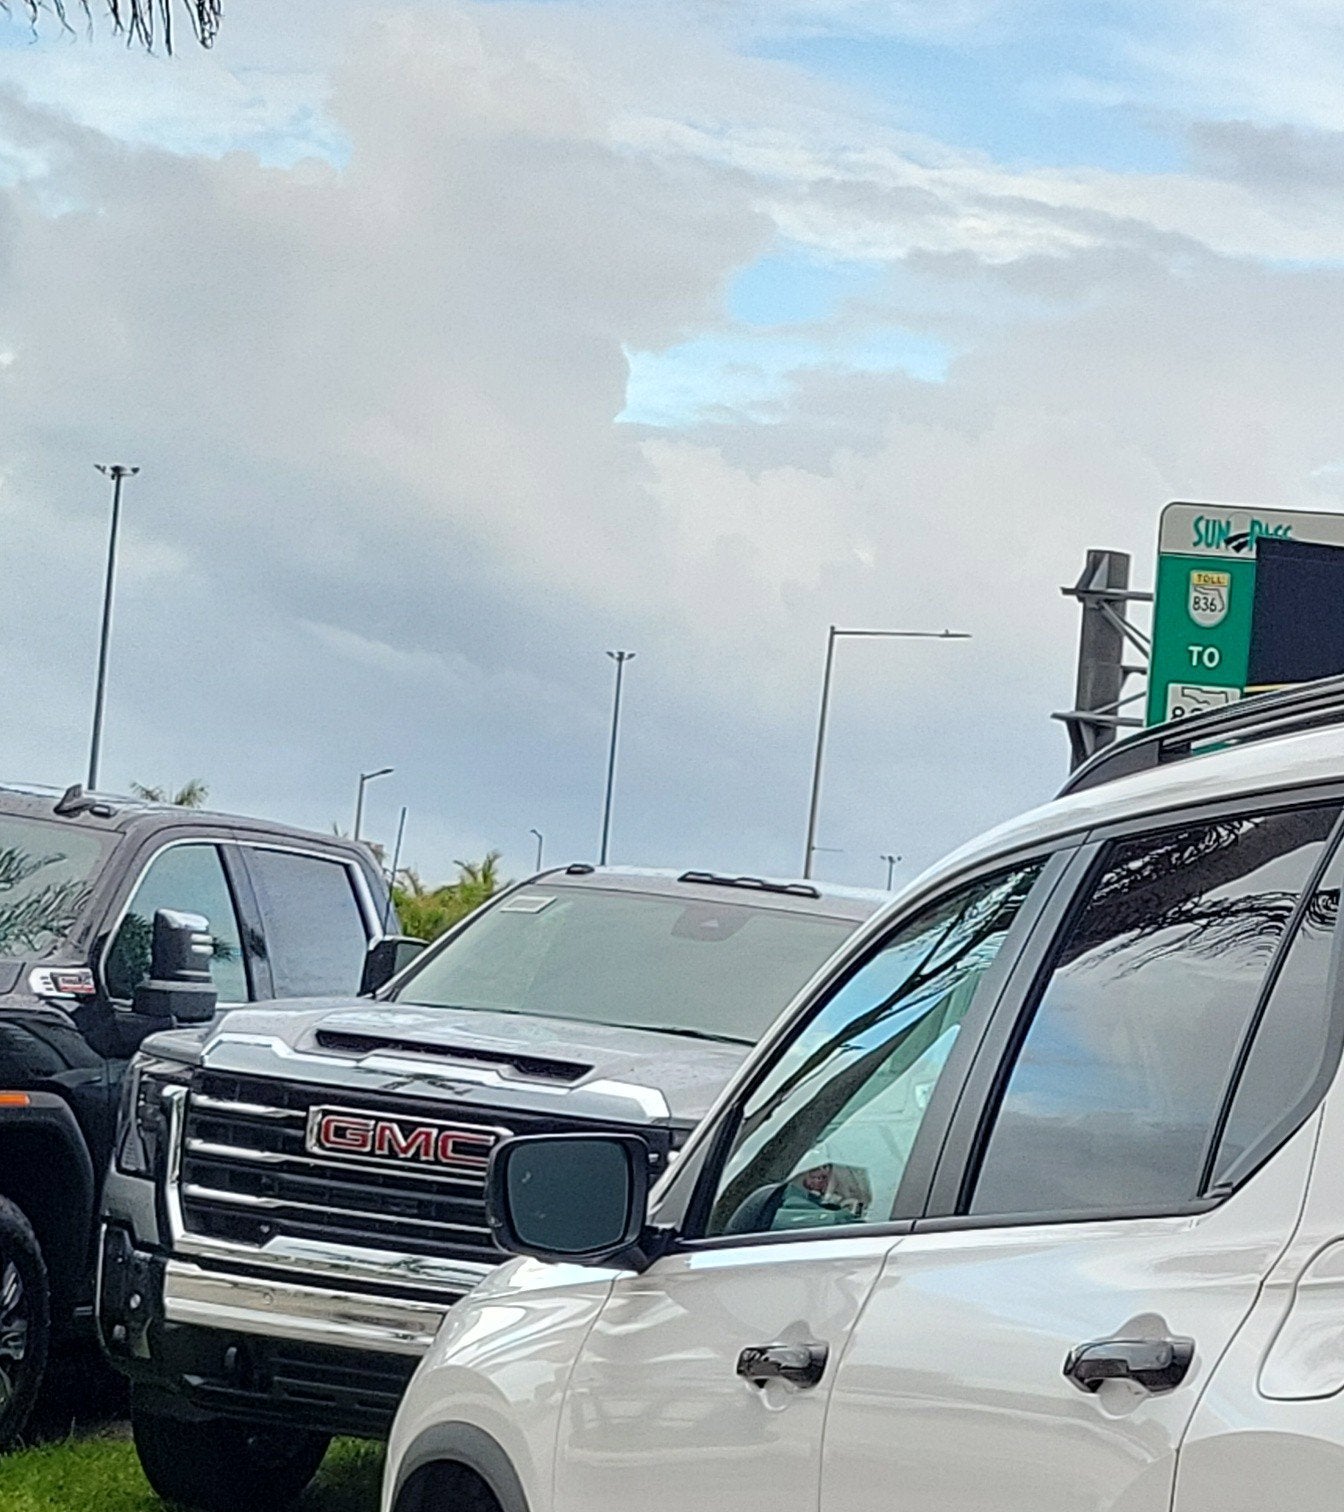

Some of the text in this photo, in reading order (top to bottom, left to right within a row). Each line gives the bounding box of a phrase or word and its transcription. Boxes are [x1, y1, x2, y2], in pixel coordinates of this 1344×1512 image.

[1196, 573, 1223, 585] TOLL
[1192, 595, 1217, 613] 836
[1188, 646, 1219, 668] TO
[321, 1115, 495, 1167] GMC
